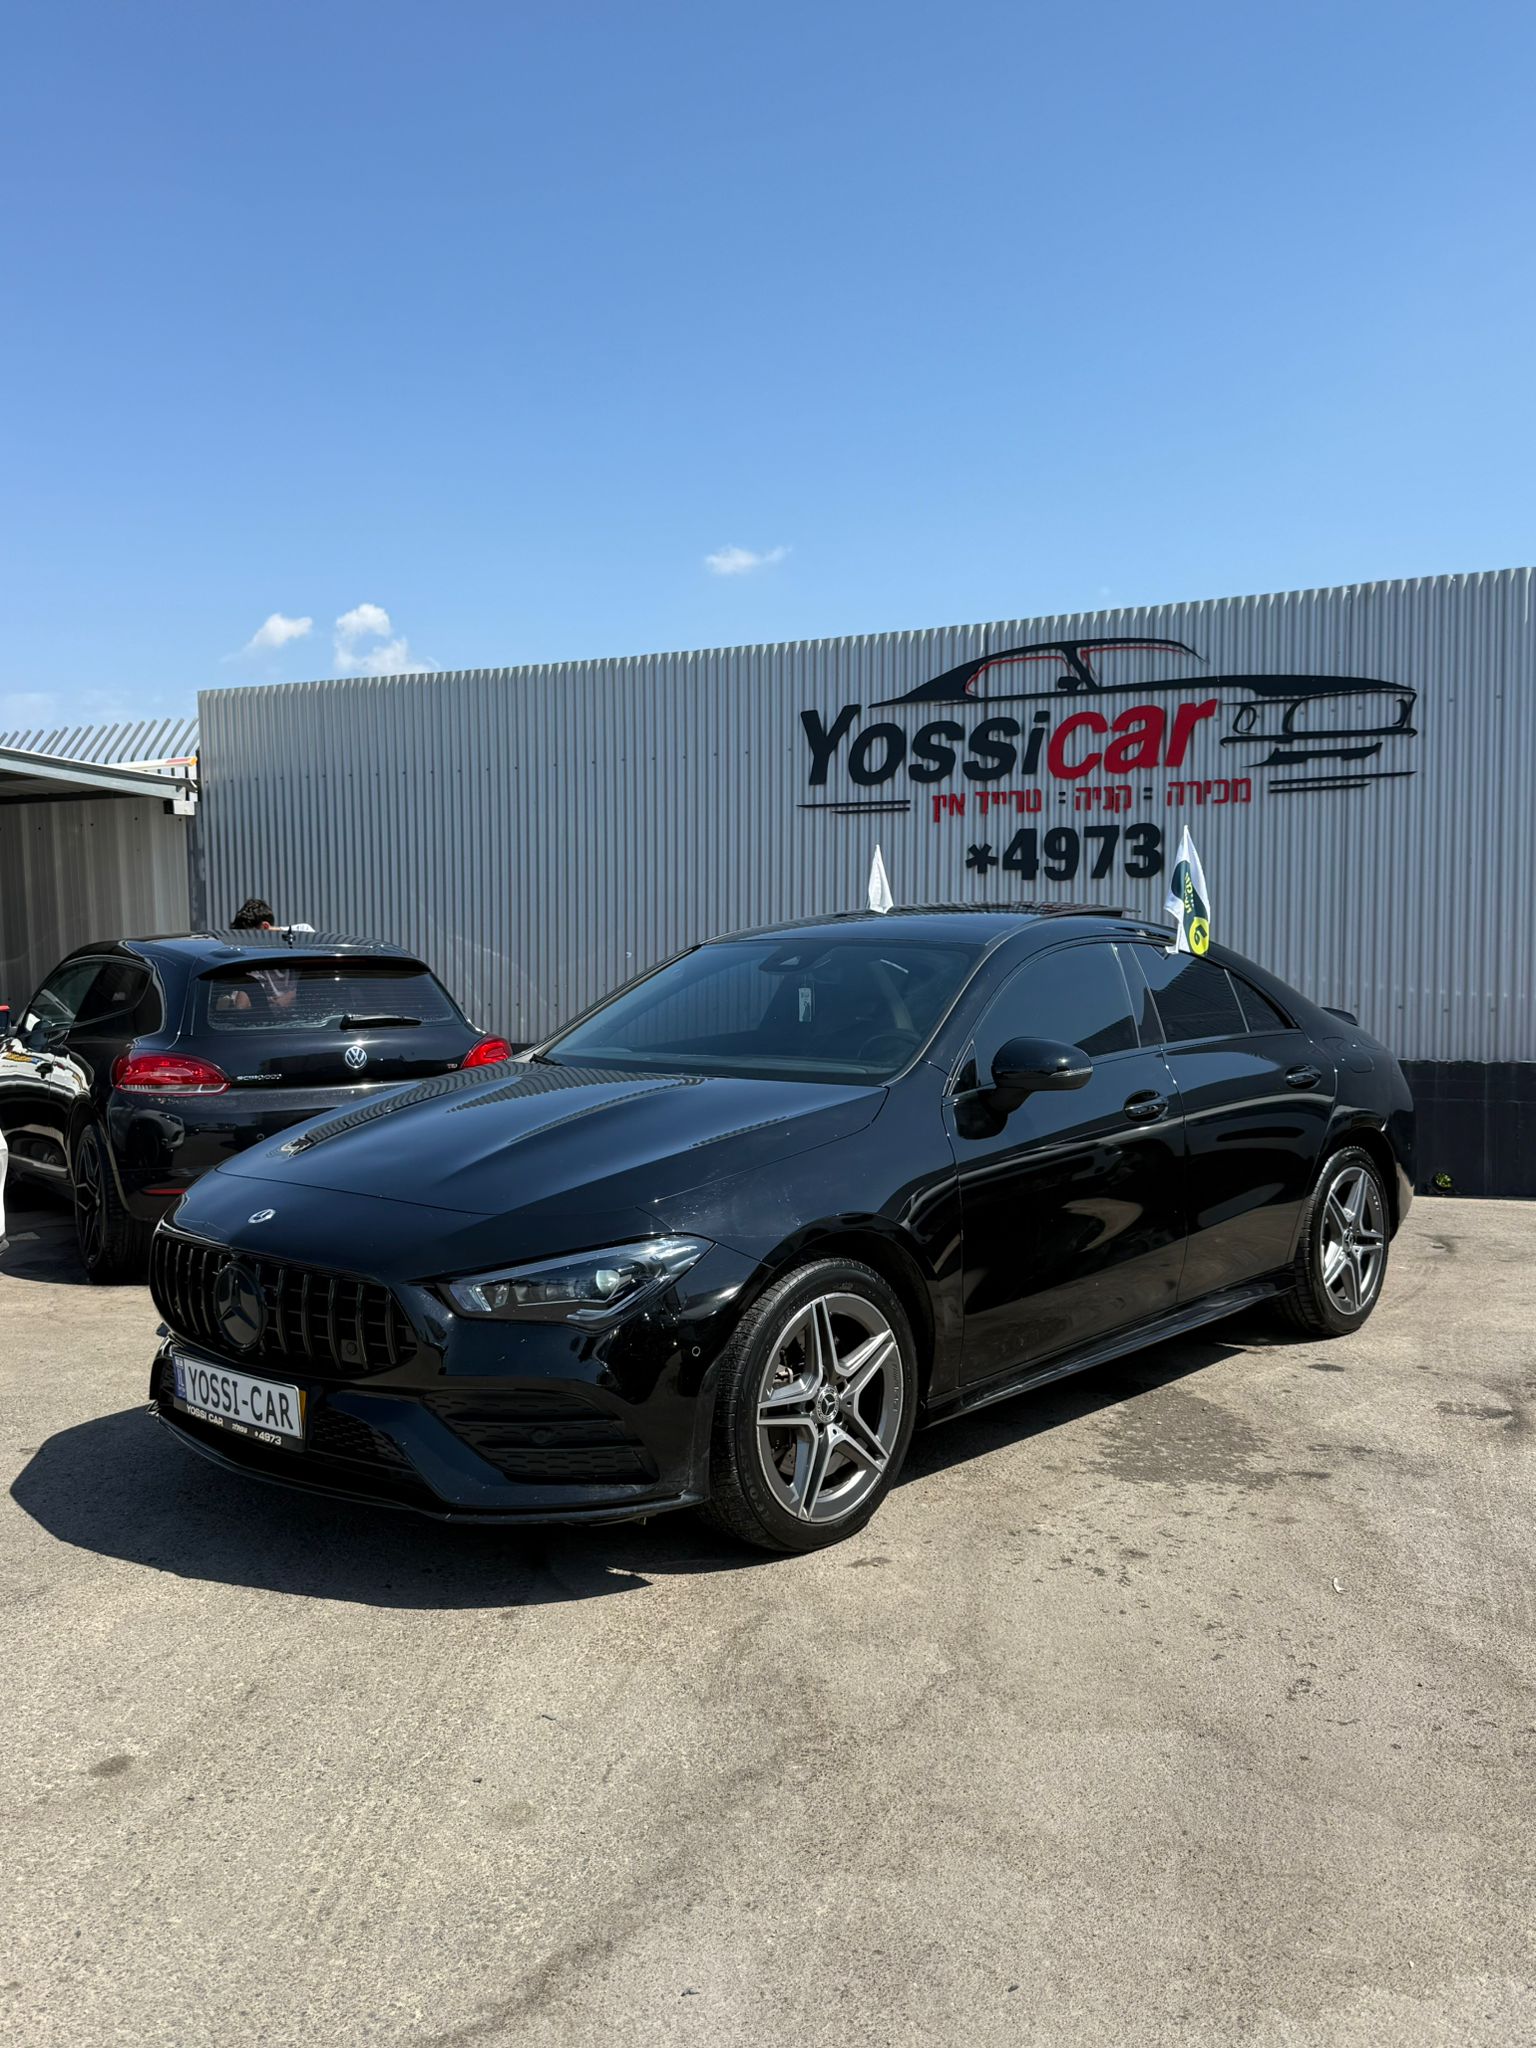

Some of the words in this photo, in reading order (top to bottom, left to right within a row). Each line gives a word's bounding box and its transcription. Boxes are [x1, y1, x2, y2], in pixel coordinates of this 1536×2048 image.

[975, 788, 1042, 816] טרייד
[1075, 785, 1132, 814] קניה
[1167, 778, 1251, 806] מכירה
[932, 793, 965, 823] אין
[188, 1366, 293, 1430] YOSSI-CAR
[186, 1404, 207, 1421] YOSSI
[208, 1413, 224, 1427] CAR
